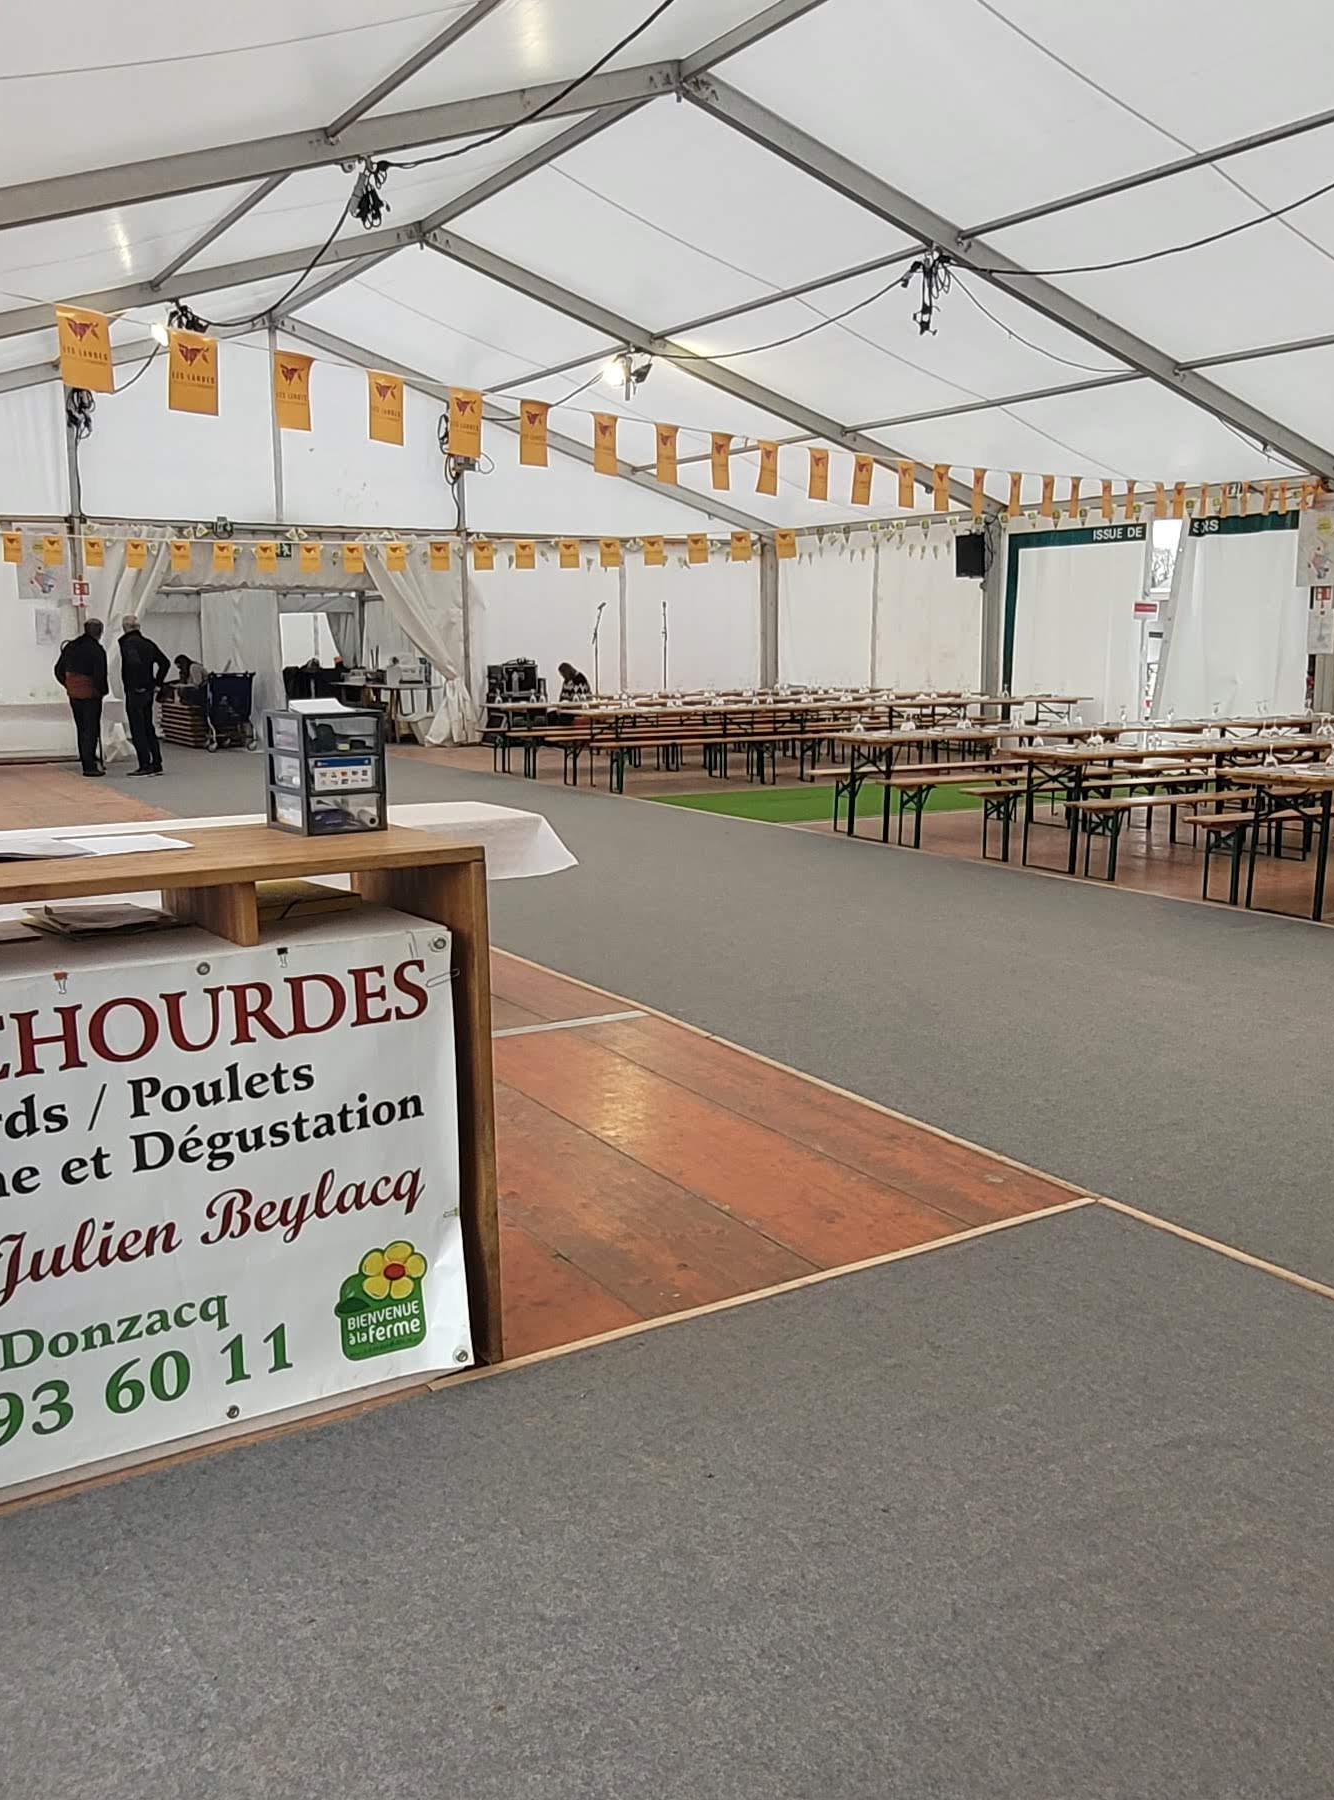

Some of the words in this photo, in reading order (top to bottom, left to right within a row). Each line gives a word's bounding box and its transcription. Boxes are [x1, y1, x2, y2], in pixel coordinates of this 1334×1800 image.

[1093, 528, 1124, 541] ISSUE
[1128, 527, 1143, 538] DE
[87, 1083, 108, 1132] /
[128, 1060, 315, 1118] Poulets
[60, 1147, 112, 1185] et
[131, 1091, 425, 1172] Dégustation
[202, 1165, 425, 1244] Beylacq
[348, 1301, 419, 1330] BIENVENUE
[369, 1318, 420, 1343] ferme
[105, 1350, 190, 1415] 60
[222, 1323, 293, 1384] 11
